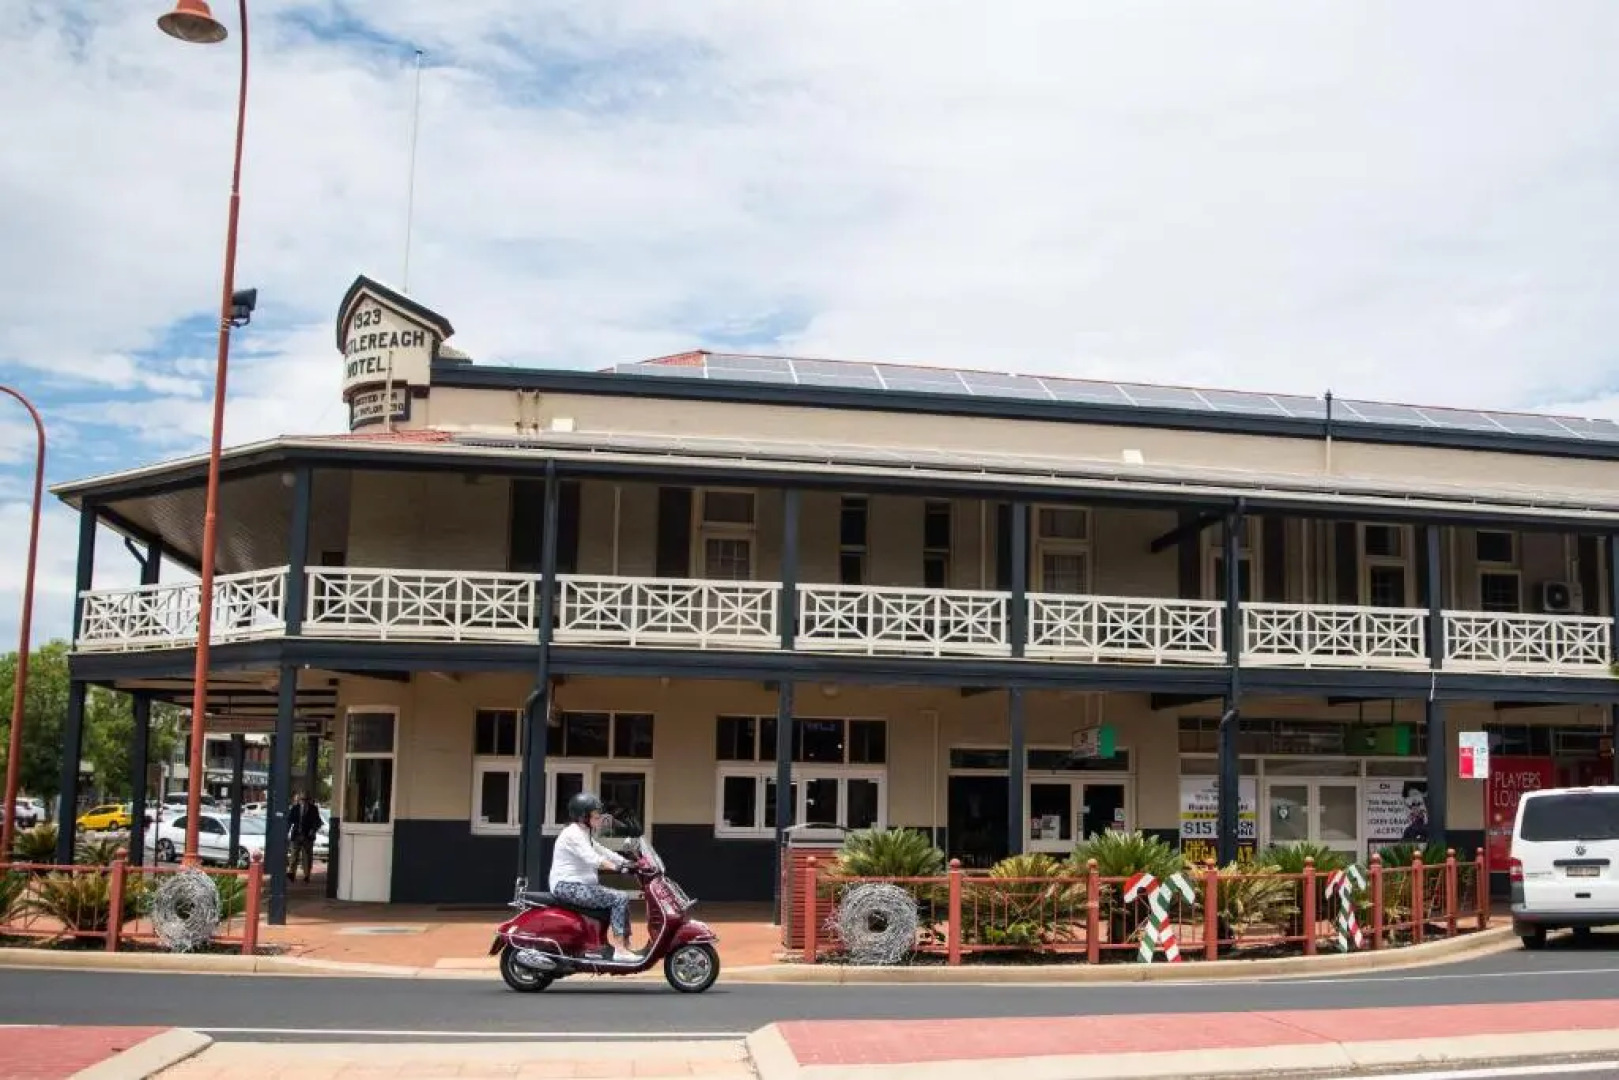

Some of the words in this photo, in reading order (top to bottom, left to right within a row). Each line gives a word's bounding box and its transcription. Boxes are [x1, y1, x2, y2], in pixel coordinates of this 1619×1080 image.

[353, 308, 382, 330] 1923
[347, 356, 387, 378] HOTEL
[1495, 771, 1541, 788] PLAYERS
